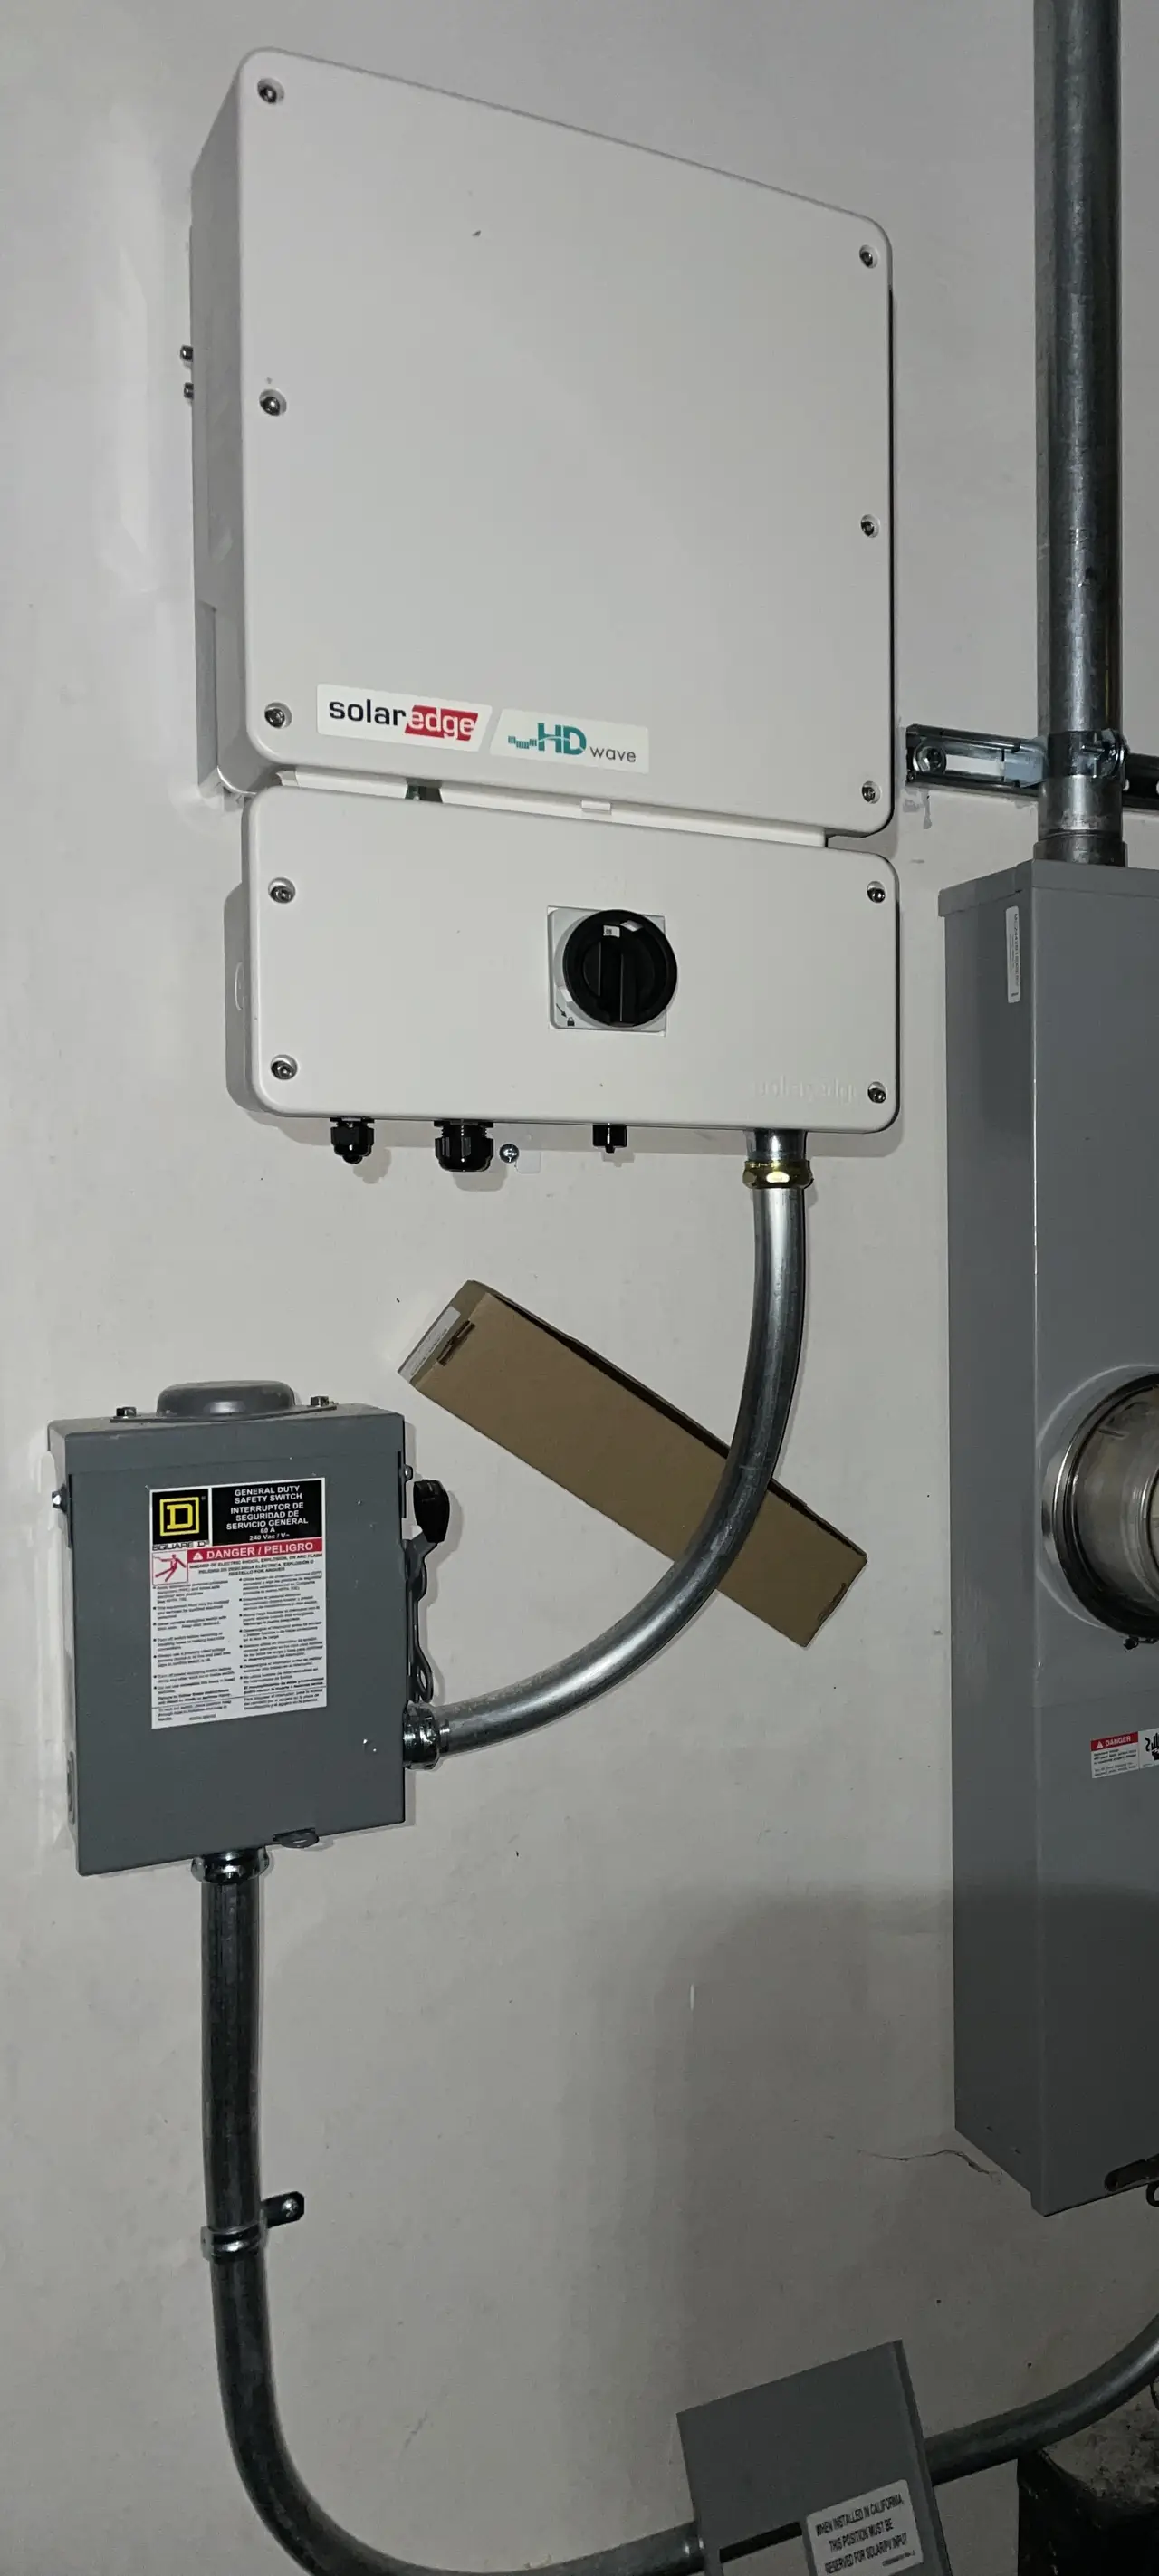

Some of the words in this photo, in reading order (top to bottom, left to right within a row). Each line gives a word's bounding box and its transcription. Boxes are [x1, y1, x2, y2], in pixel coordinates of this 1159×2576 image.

[329, 699, 475, 740] solaredge
[538, 723, 587, 755] HD
[589, 746, 637, 763] wave
[235, 1487, 275, 1496] GENERAL
[277, 1485, 300, 1493] DUTY
[235, 1496, 267, 1504] SAFETY
[270, 1493, 302, 1501] SWITCH
[231, 1503, 291, 1514] INTERRUPTOR
[167, 1504, 193, 1529] D
[235, 1511, 285, 1521] SEGURIDAD
[226, 1521, 266, 1530] SERVICIO
[268, 1518, 309, 1527] GENERAL
[152, 1541, 194, 1551] SQUARE
[206, 1544, 255, 1559] DANGER
[257, 1545, 262, 1556] /
[264, 1542, 313, 1555] PELIGRO
[1105, 1736, 1131, 1747] DANGER
[816, 2523, 833, 2536] WHEN
[832, 2509, 863, 2529] INSTALLED
[862, 2506, 870, 2518] IN
[829, 2537, 842, 2553] THIS
[842, 2528, 869, 2546] POSITION
[868, 2521, 884, 2536] MUST
[884, 2518, 894, 2532] BE
[824, 2554, 854, 2574] RESERVED
[853, 2549, 865, 2564] FOR
[891, 2533, 908, 2550] INPUT
